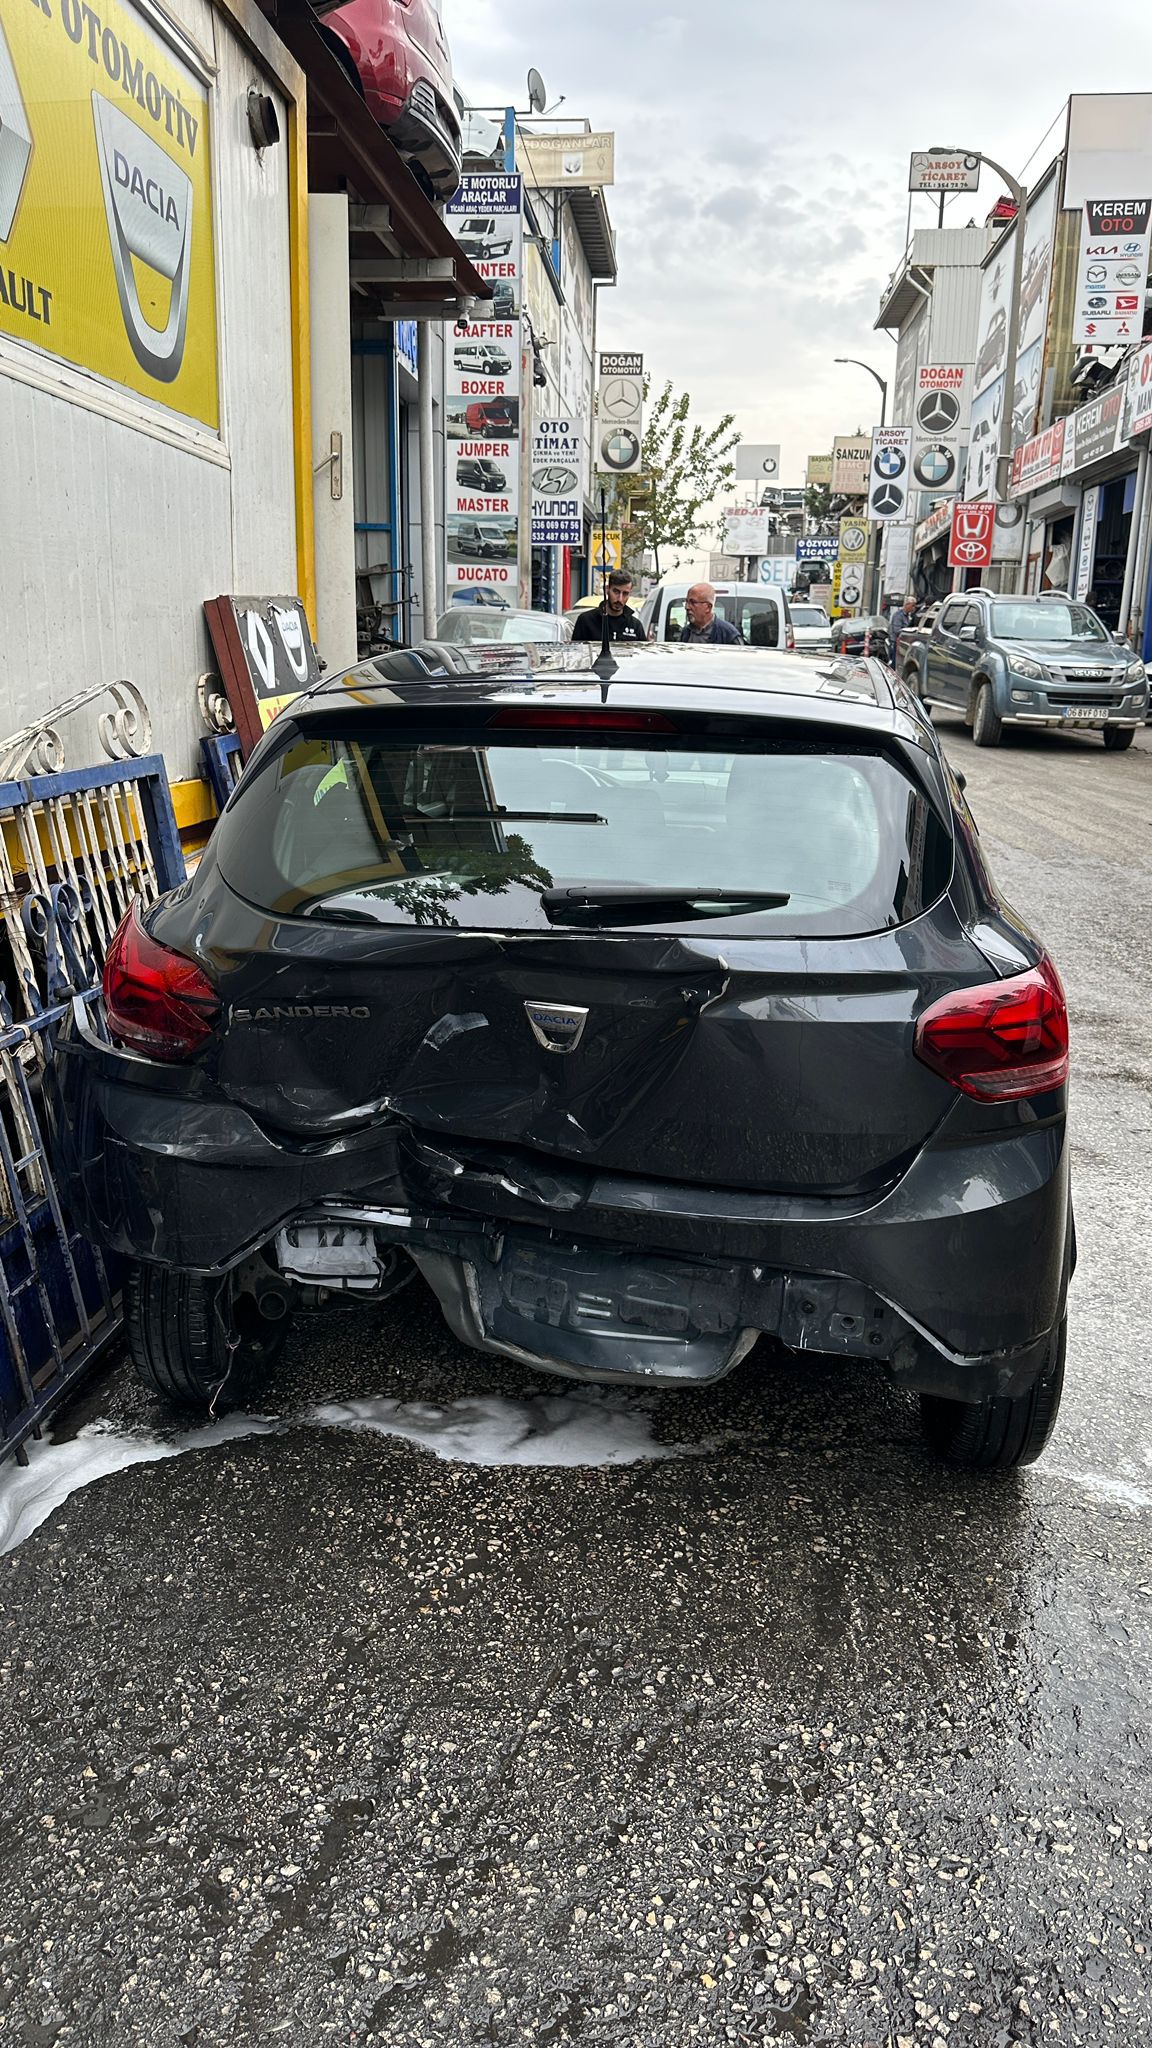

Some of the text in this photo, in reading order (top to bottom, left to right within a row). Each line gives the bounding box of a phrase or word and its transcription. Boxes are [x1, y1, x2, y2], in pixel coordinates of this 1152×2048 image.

[61, 0, 198, 157] OTOMOTİV
[927, 161, 963, 169] ARSOY
[920, 171, 967, 181] TİCARET
[113, 148, 181, 232] DACIA
[471, 177, 517, 190] MOTORLU
[461, 191, 506, 205] ARAÇLAR
[1092, 202, 1146, 217] KEREM
[1101, 218, 1134, 232] OTO
[454, 324, 513, 338] CRAFTER
[602, 355, 641, 366] DOĞAN
[920, 365, 963, 379] DOĞAN
[461, 381, 505, 395] BOXER
[1102, 394, 1121, 421] OTO
[540, 422, 569, 433] OTO
[875, 437, 909, 445] TİCARET
[457, 443, 509, 457] JUMPER
[457, 498, 509, 512] MASTER
[560, 521, 569, 529] 67
[546, 533, 559, 541] 487
[560, 533, 569, 541] 69
[570, 533, 579, 541] 72
[806, 539, 839, 548] ÖZYOLU
[457, 568, 509, 582] DUCATO
[234, 1005, 371, 1022] SANDERO
[532, 1012, 578, 1027] DACIA
